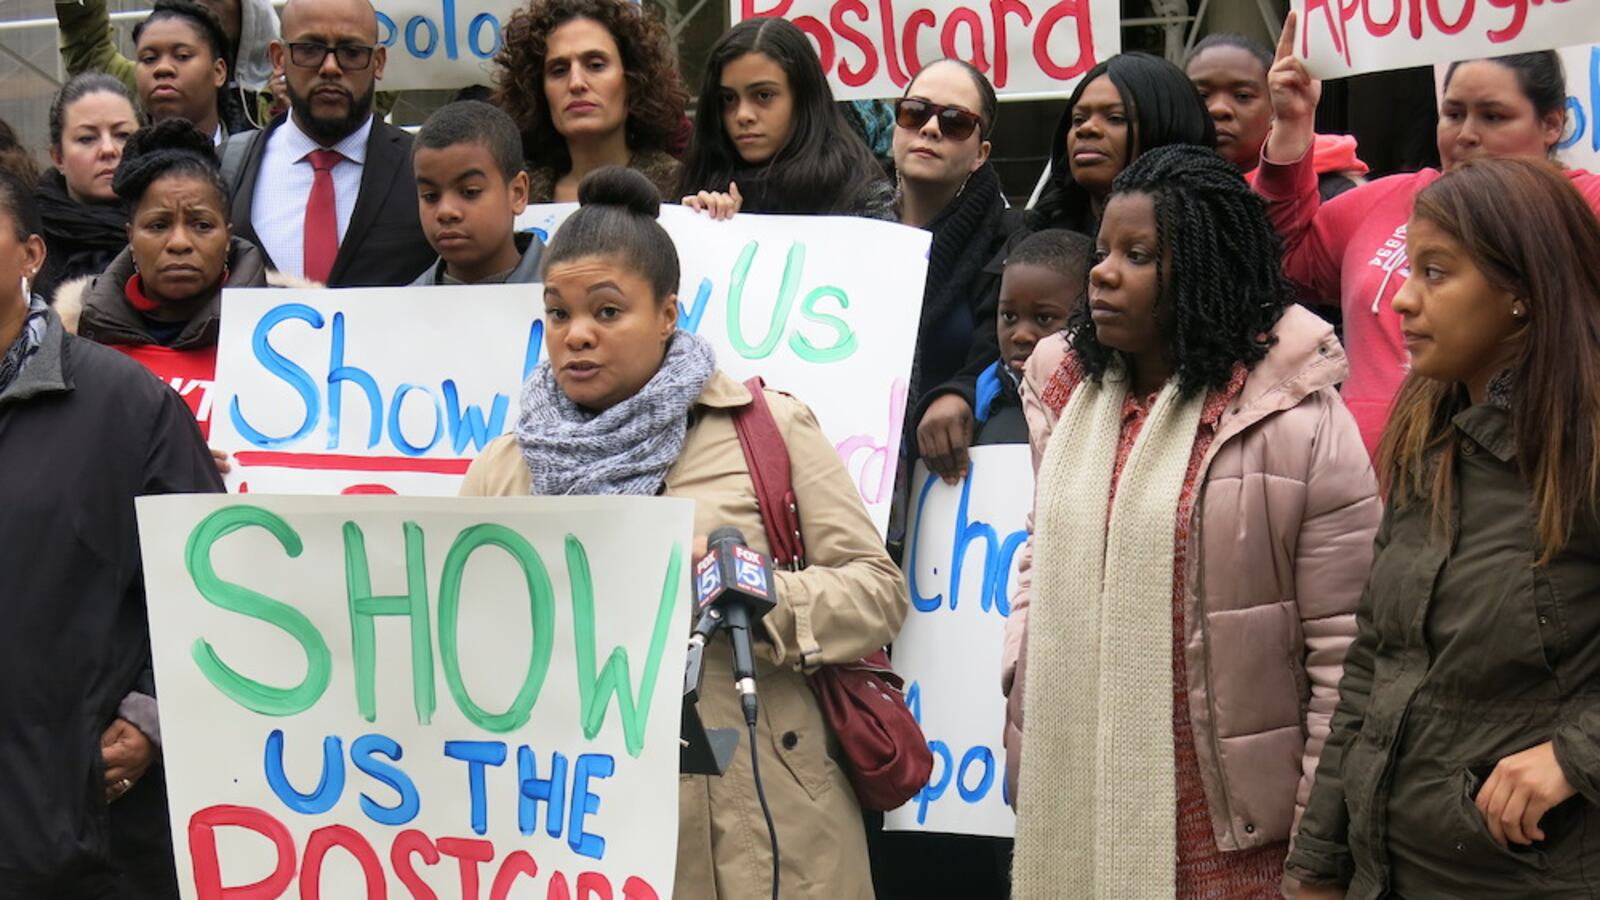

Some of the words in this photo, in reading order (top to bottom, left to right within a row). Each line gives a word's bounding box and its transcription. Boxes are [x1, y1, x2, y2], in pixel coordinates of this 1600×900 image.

[726, 240, 858, 364] Us
[229, 303, 509, 456] Show
[702, 562, 717, 595] 5
[735, 546, 761, 565] FOX
[741, 561, 761, 587] 5
[184, 504, 684, 758] SHOW
[264, 729, 420, 826] US
[444, 741, 615, 860] THE
